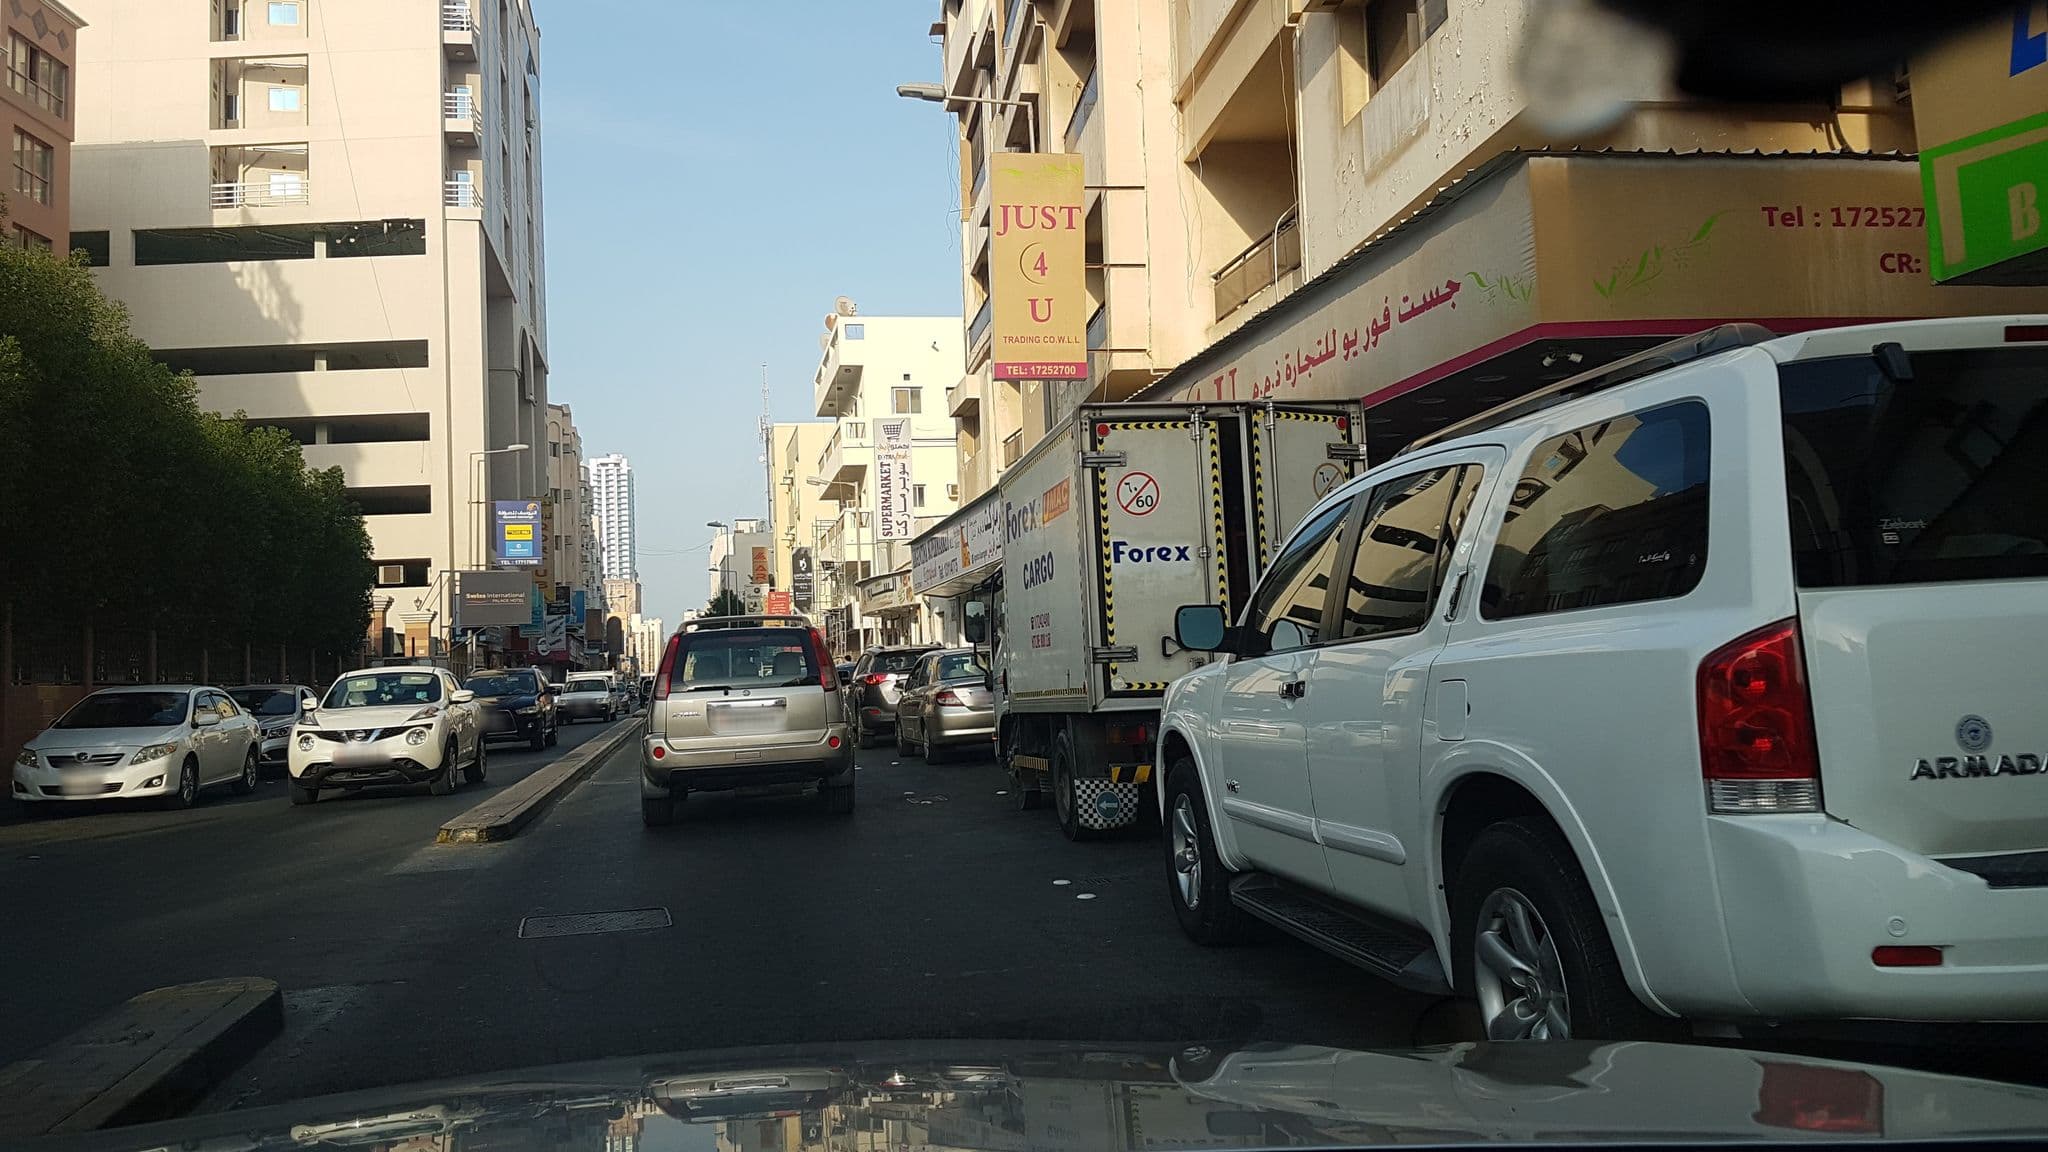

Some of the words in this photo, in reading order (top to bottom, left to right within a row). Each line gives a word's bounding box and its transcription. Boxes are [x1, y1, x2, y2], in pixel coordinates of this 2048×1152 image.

[996, 204, 1082, 236] JUST
[1761, 206, 1804, 228] Tel
[1033, 251, 1048, 277] 4
[1879, 252, 1922, 274] CR:
[1028, 298, 1054, 323] U
[1398, 279, 1462, 325] جست
[1003, 335, 1041, 344] TRADING
[1285, 328, 1338, 387] للتجارة
[1006, 365, 1028, 376] TEL:
[1030, 365, 1077, 375] 17252700
[880, 461, 893, 537] SUPERMARKET
[1135, 494, 1154, 508] 60
[1006, 499, 1037, 545] Forex
[1112, 541, 1191, 564] Forex
[1023, 551, 1054, 591] CARGO
